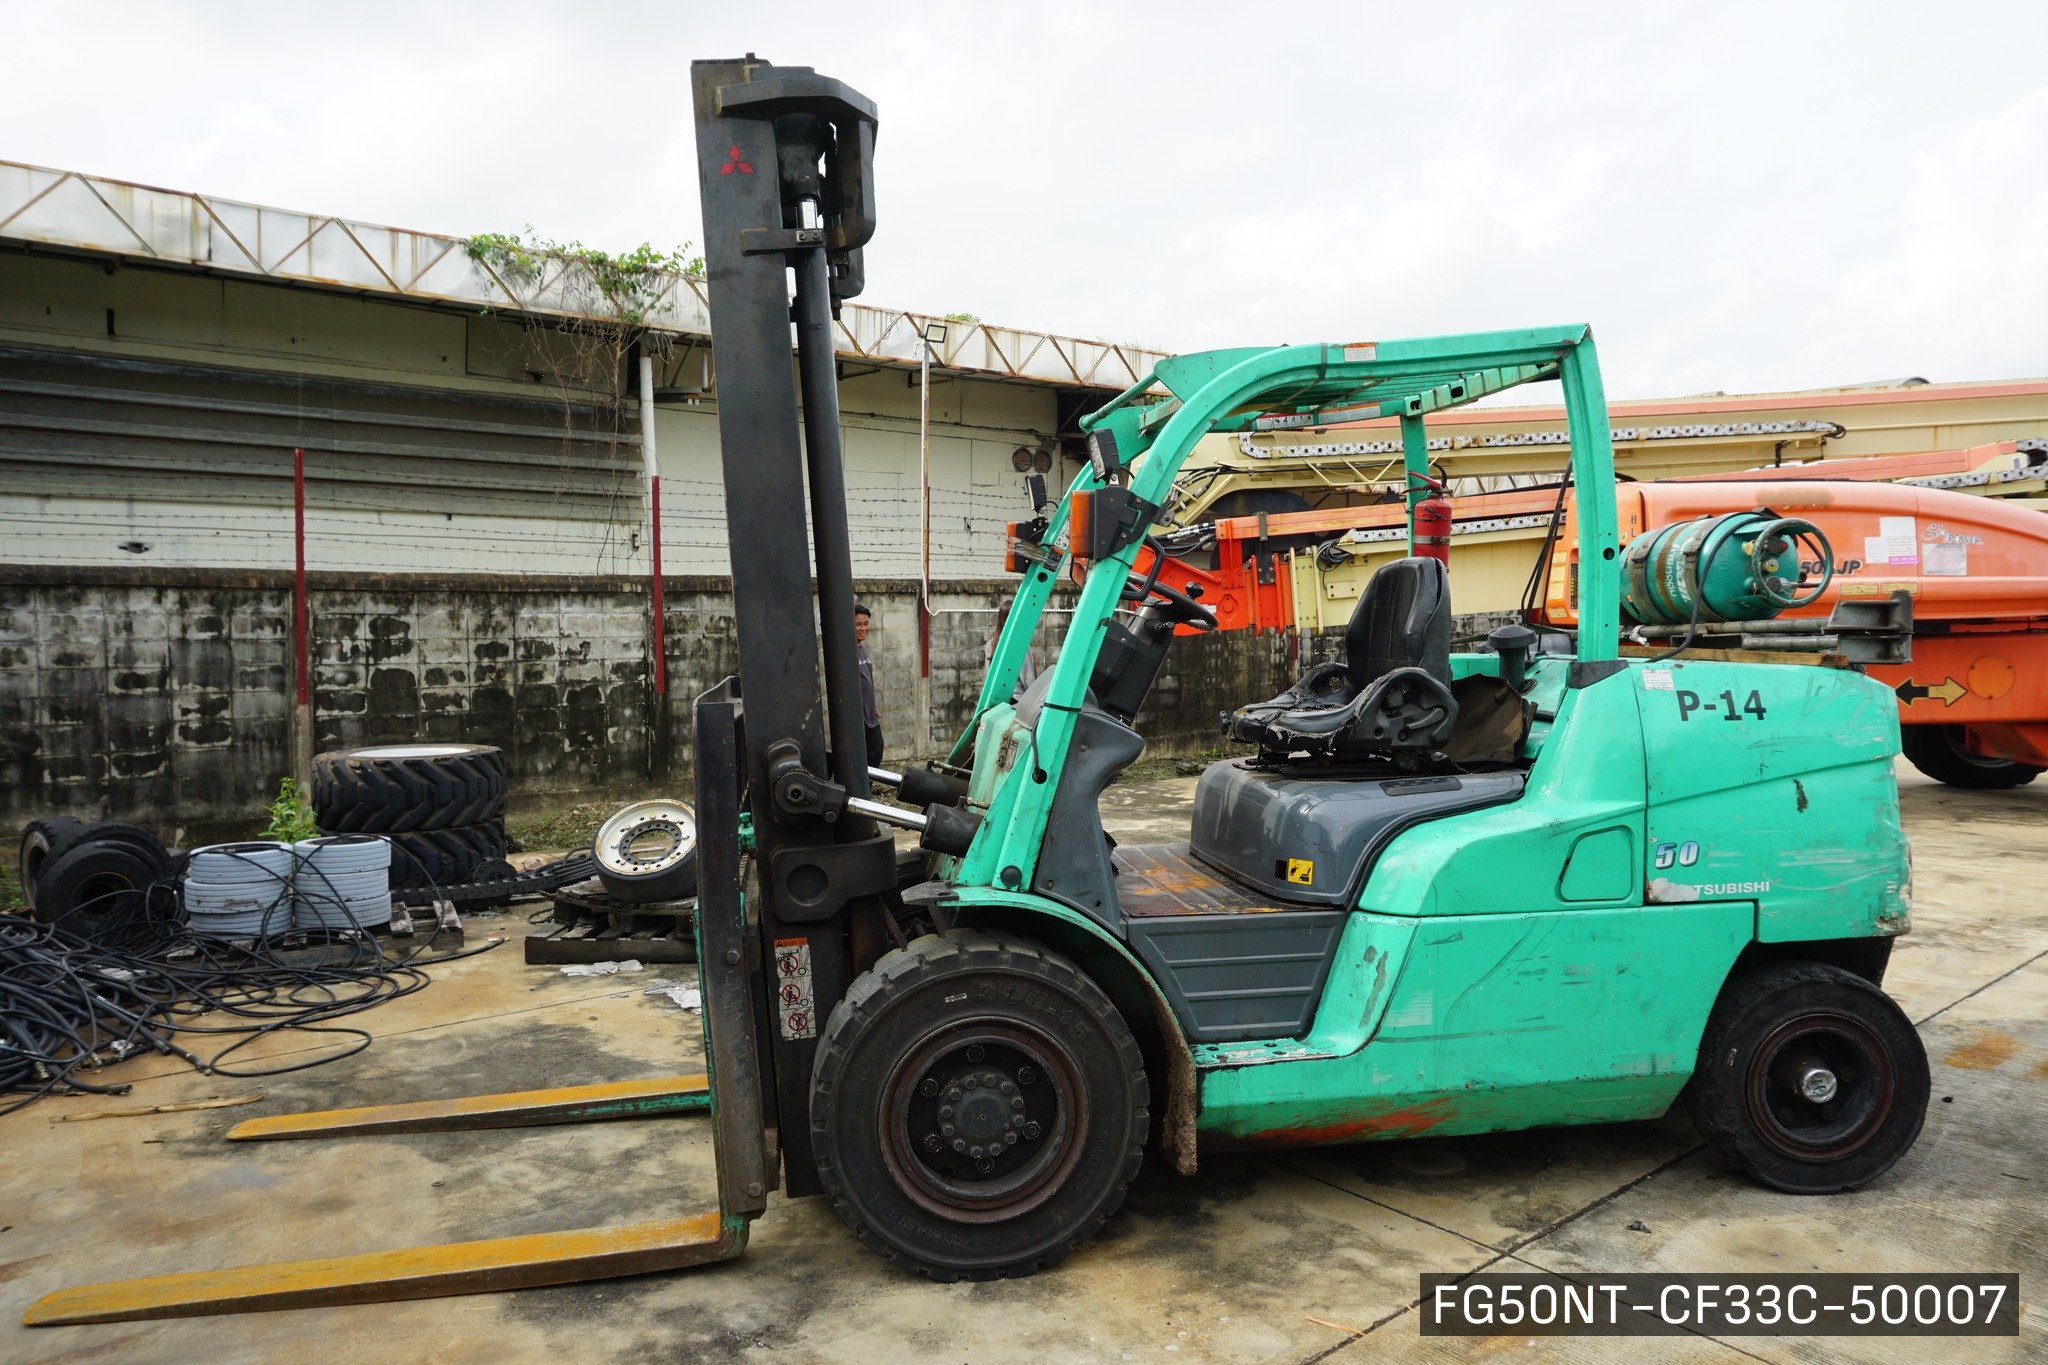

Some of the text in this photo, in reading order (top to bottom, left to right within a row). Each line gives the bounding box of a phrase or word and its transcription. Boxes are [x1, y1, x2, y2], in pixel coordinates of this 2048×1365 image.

[1676, 690, 1767, 721] P-14
[1654, 840, 1700, 870] 50
[1692, 881, 1771, 896] TSUBISHI
